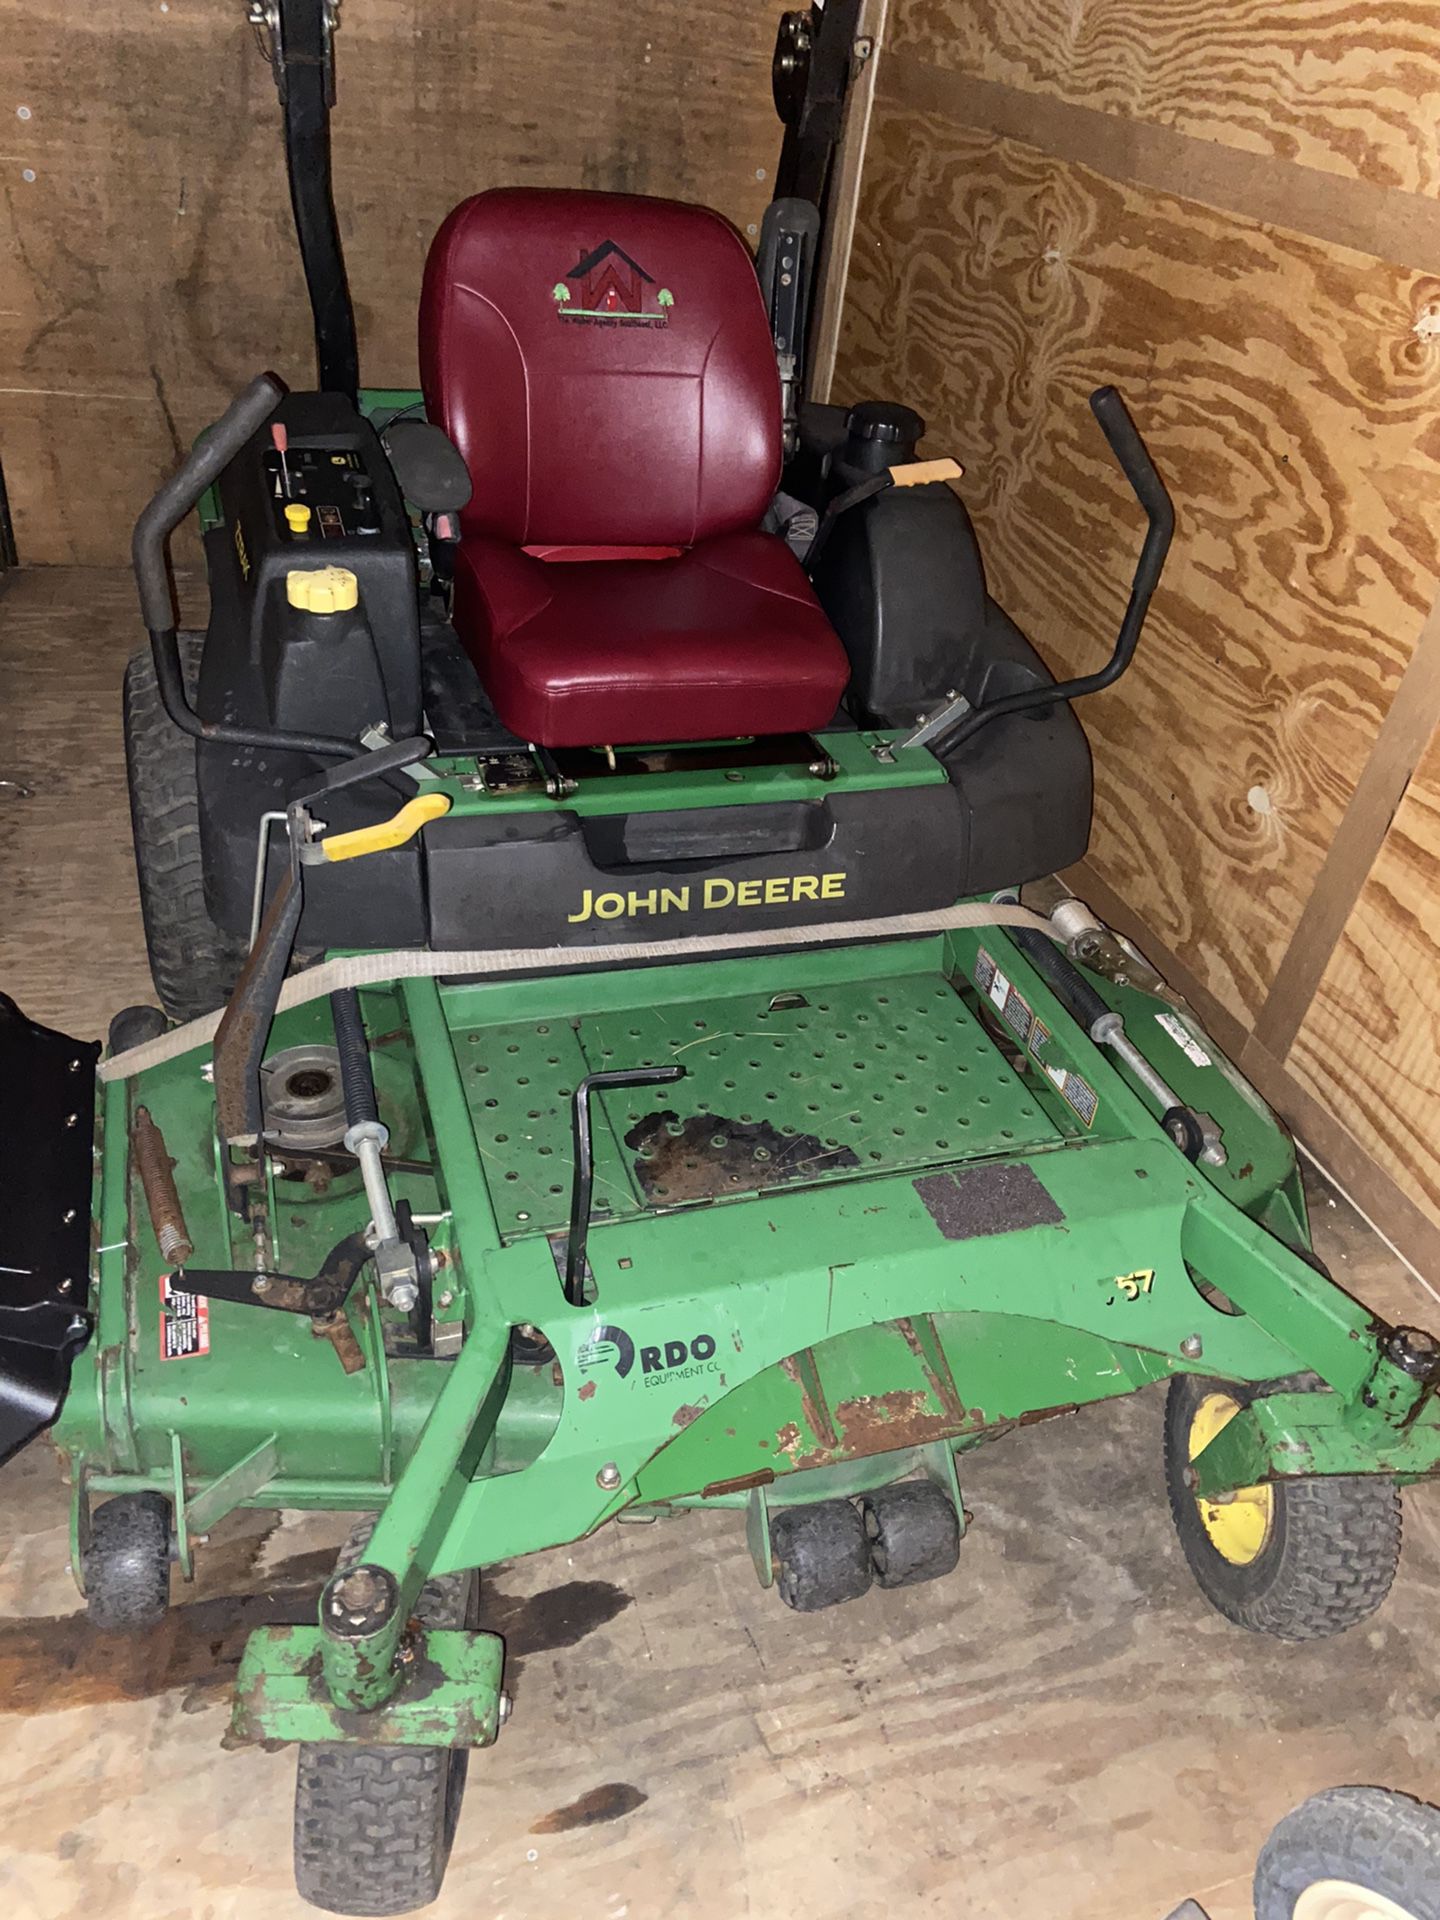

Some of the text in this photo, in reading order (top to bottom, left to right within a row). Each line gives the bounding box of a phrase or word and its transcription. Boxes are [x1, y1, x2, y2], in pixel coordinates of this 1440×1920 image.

[594, 318, 618, 329] Agency
[655, 320, 669, 329] LLC
[640, 1334, 716, 1374] RDO
